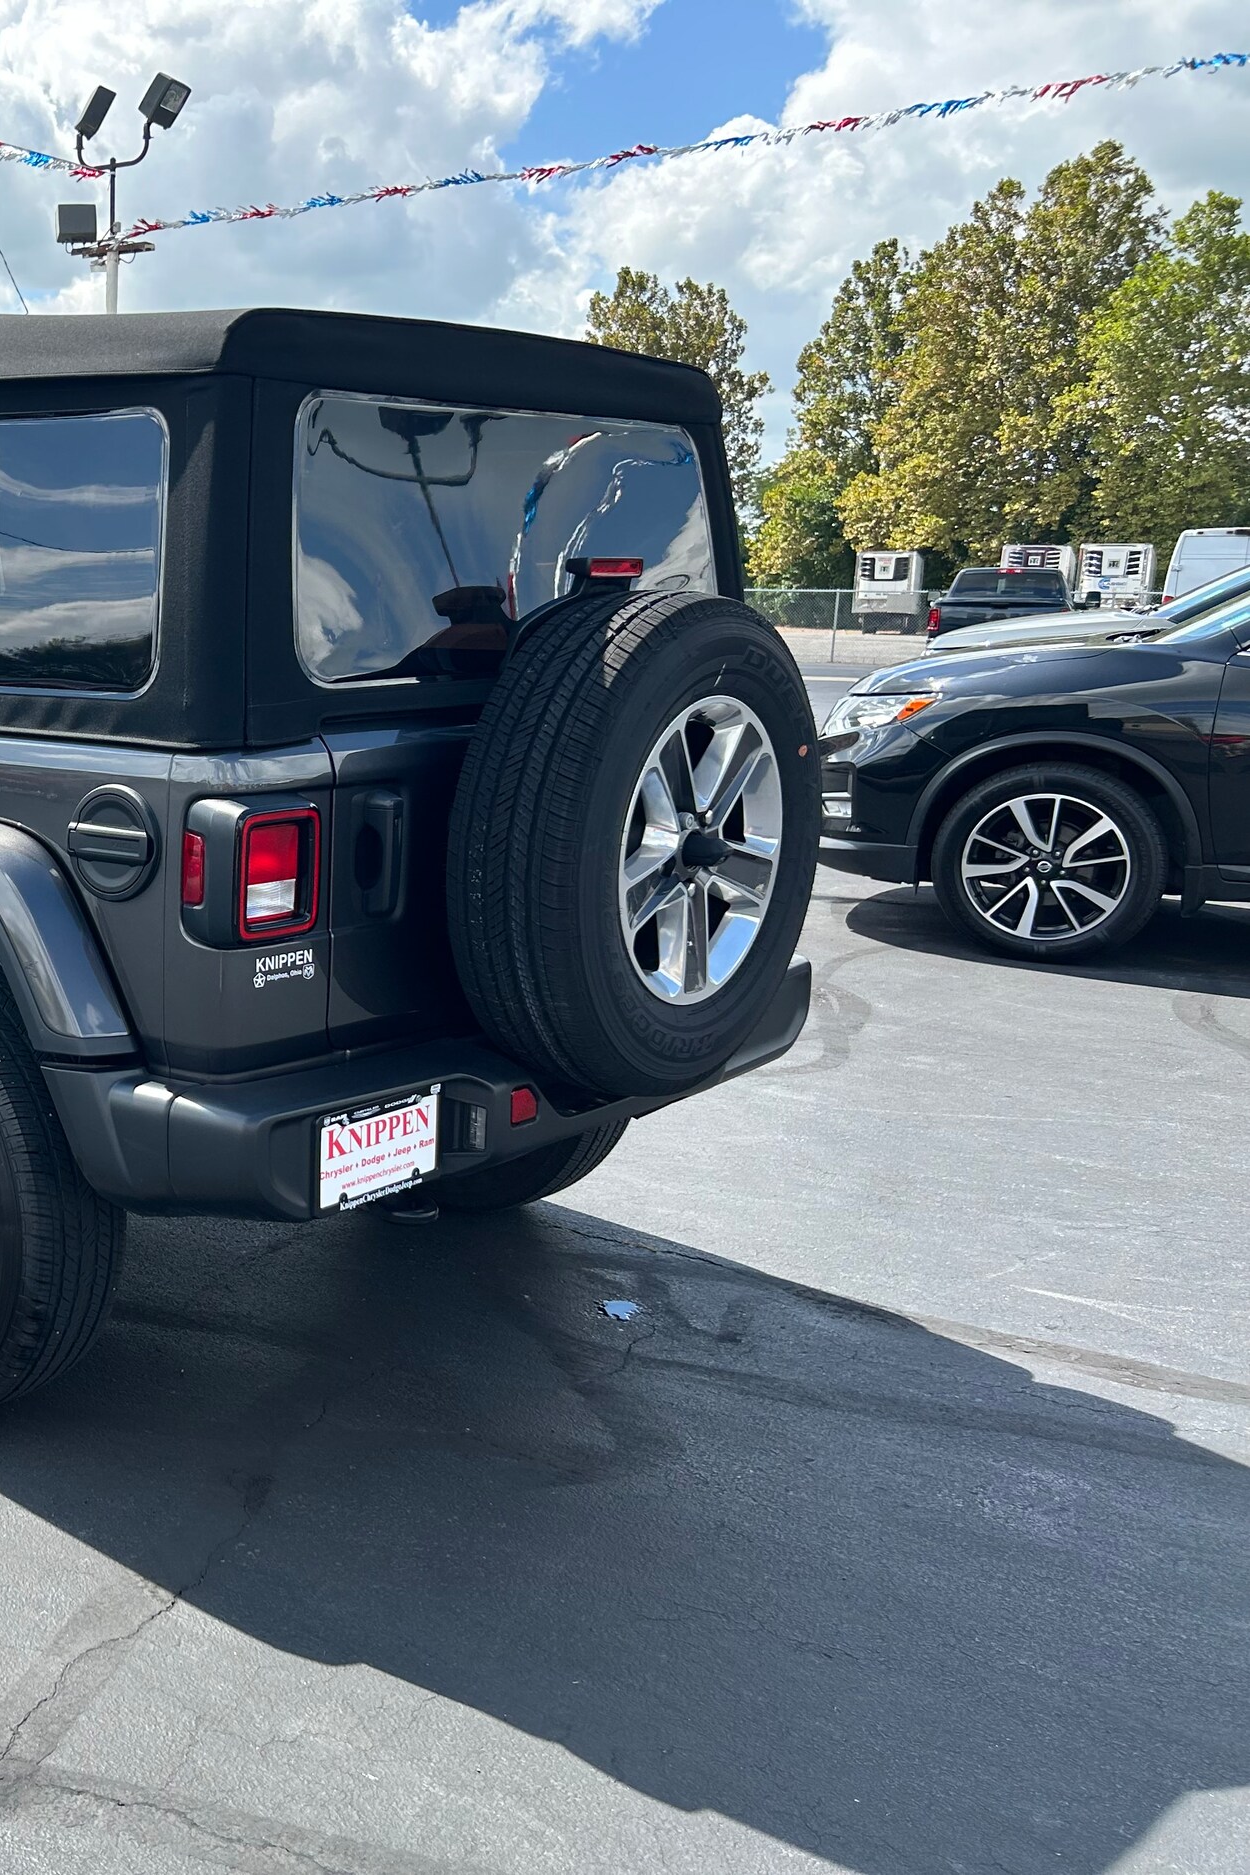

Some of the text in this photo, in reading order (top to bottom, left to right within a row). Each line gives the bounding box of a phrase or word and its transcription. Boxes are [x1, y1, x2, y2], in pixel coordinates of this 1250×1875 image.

[255, 948, 313, 973] KNIPPEN
[326, 1105, 430, 1160] KNIPPEN
[320, 1137, 435, 1180] Chrysler Dodge Jeep Ram
